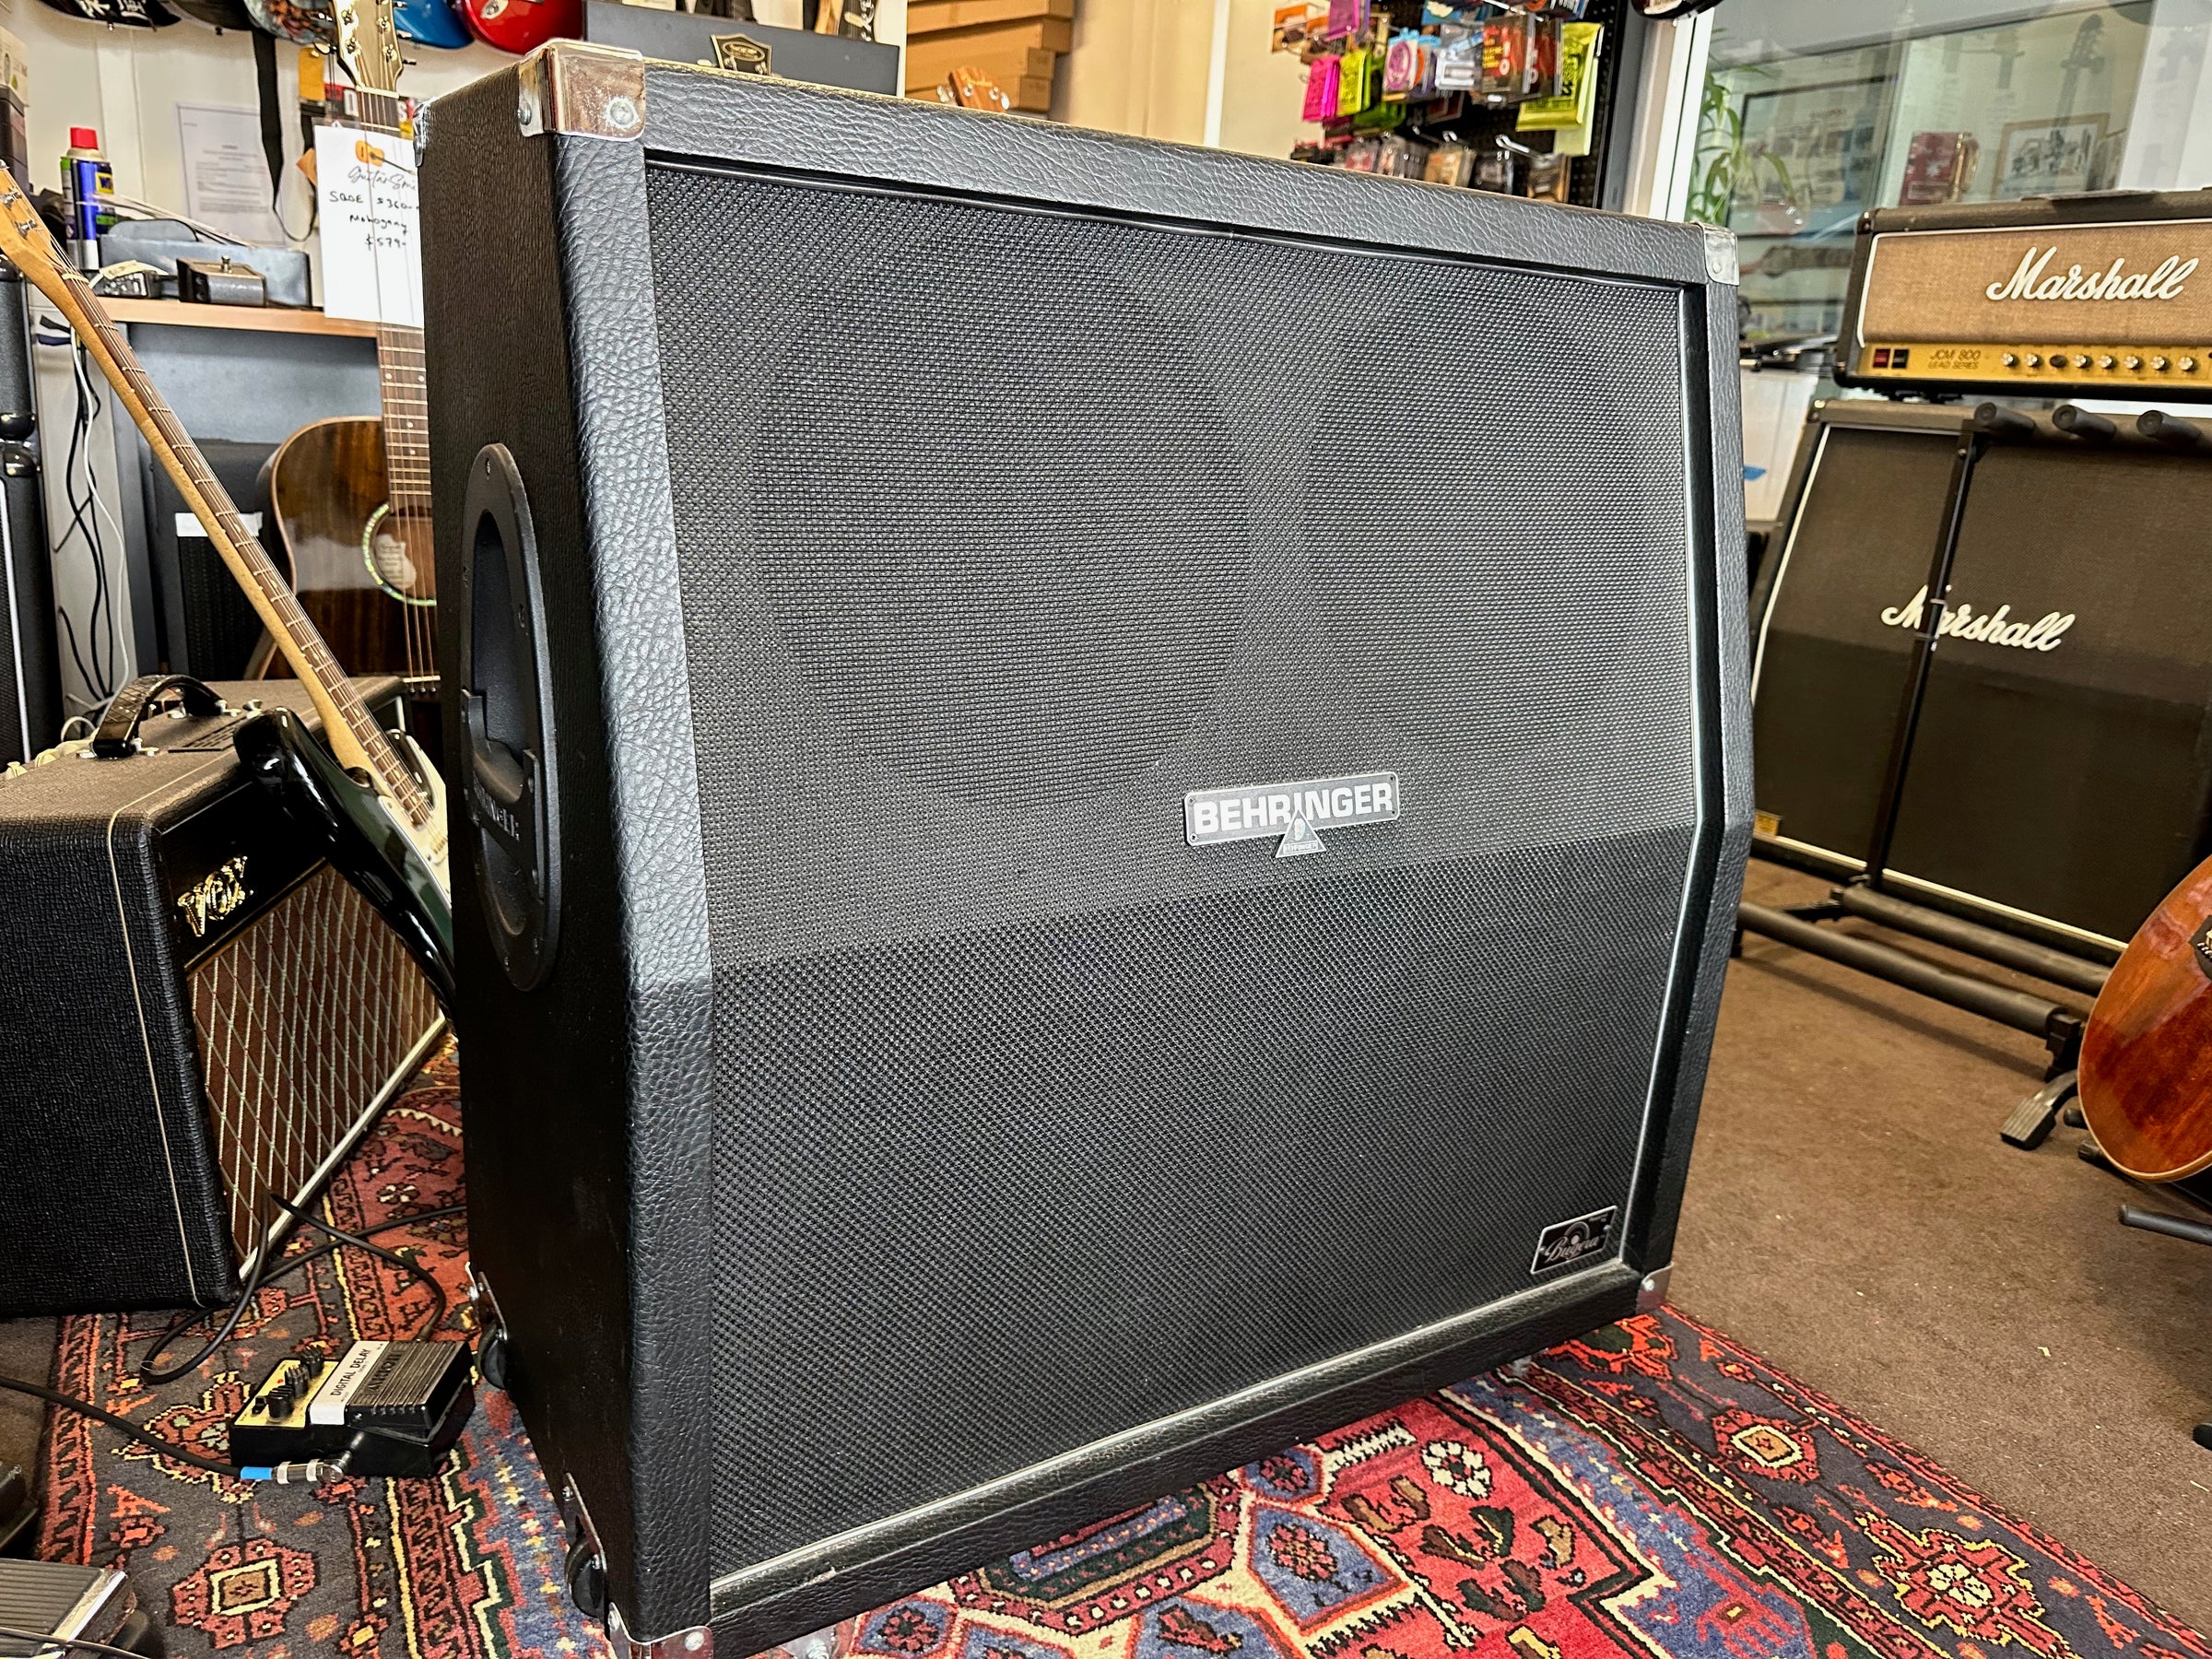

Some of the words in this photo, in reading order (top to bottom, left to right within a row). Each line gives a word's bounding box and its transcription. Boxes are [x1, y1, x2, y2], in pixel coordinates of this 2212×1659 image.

[1985, 245, 2200, 300] Marshall
[1930, 348, 1955, 361] JCM
[1958, 348, 1982, 361] 800
[1881, 584, 2075, 652] Marshall
[1196, 782, 1394, 835] BEHRINGER
[330, 1370, 359, 1397] DIGITAL
[350, 1347, 371, 1371] DELAY
